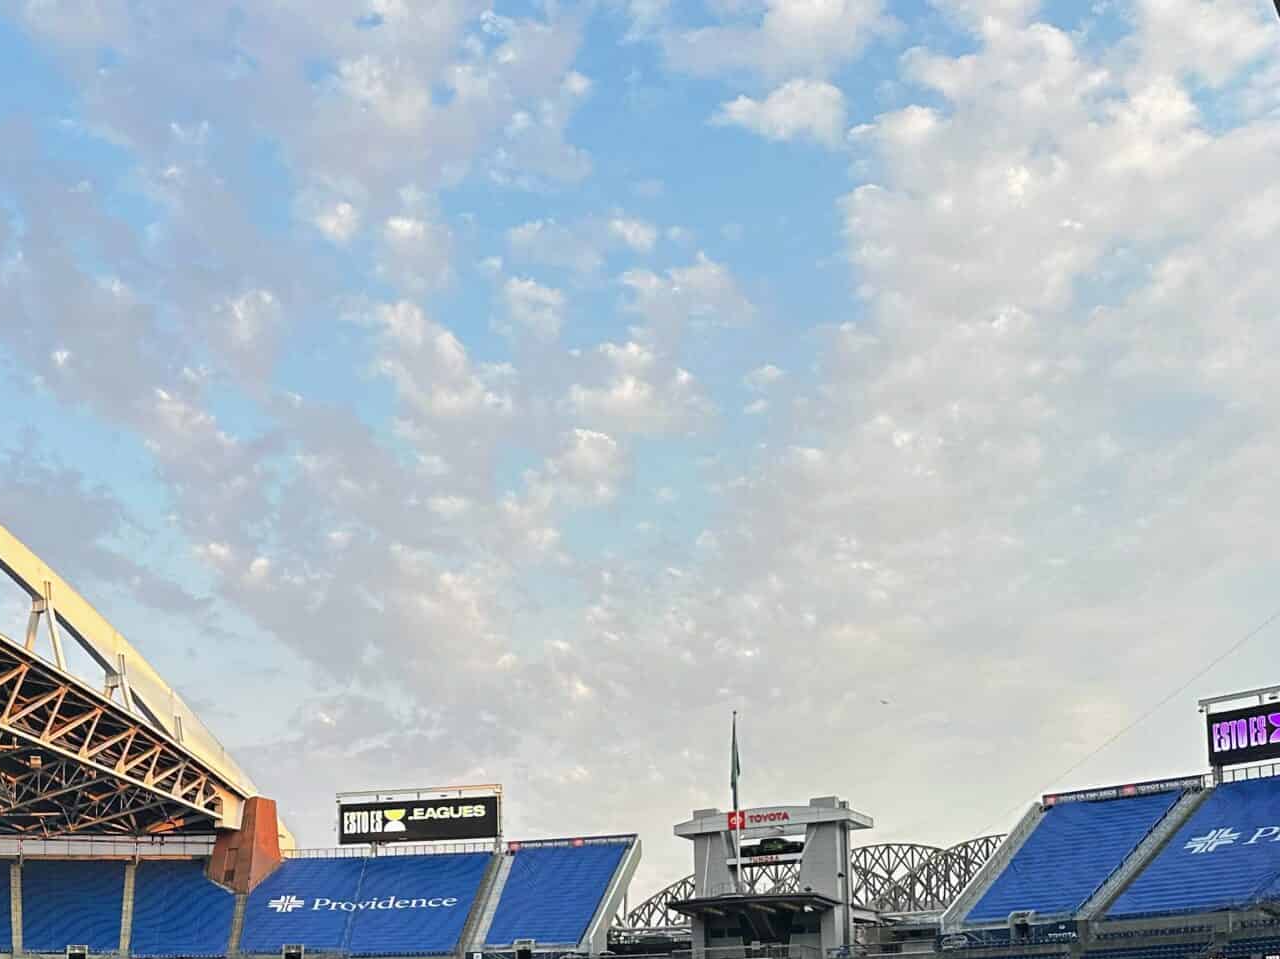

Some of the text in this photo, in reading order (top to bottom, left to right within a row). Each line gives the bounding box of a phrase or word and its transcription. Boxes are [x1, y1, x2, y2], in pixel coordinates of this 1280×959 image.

[1213, 715, 1267, 752] ESTO ES
[344, 804, 486, 834] ESTO ES EAGUES
[749, 812, 790, 823] TOYOTA
[312, 895, 458, 912] Providence
